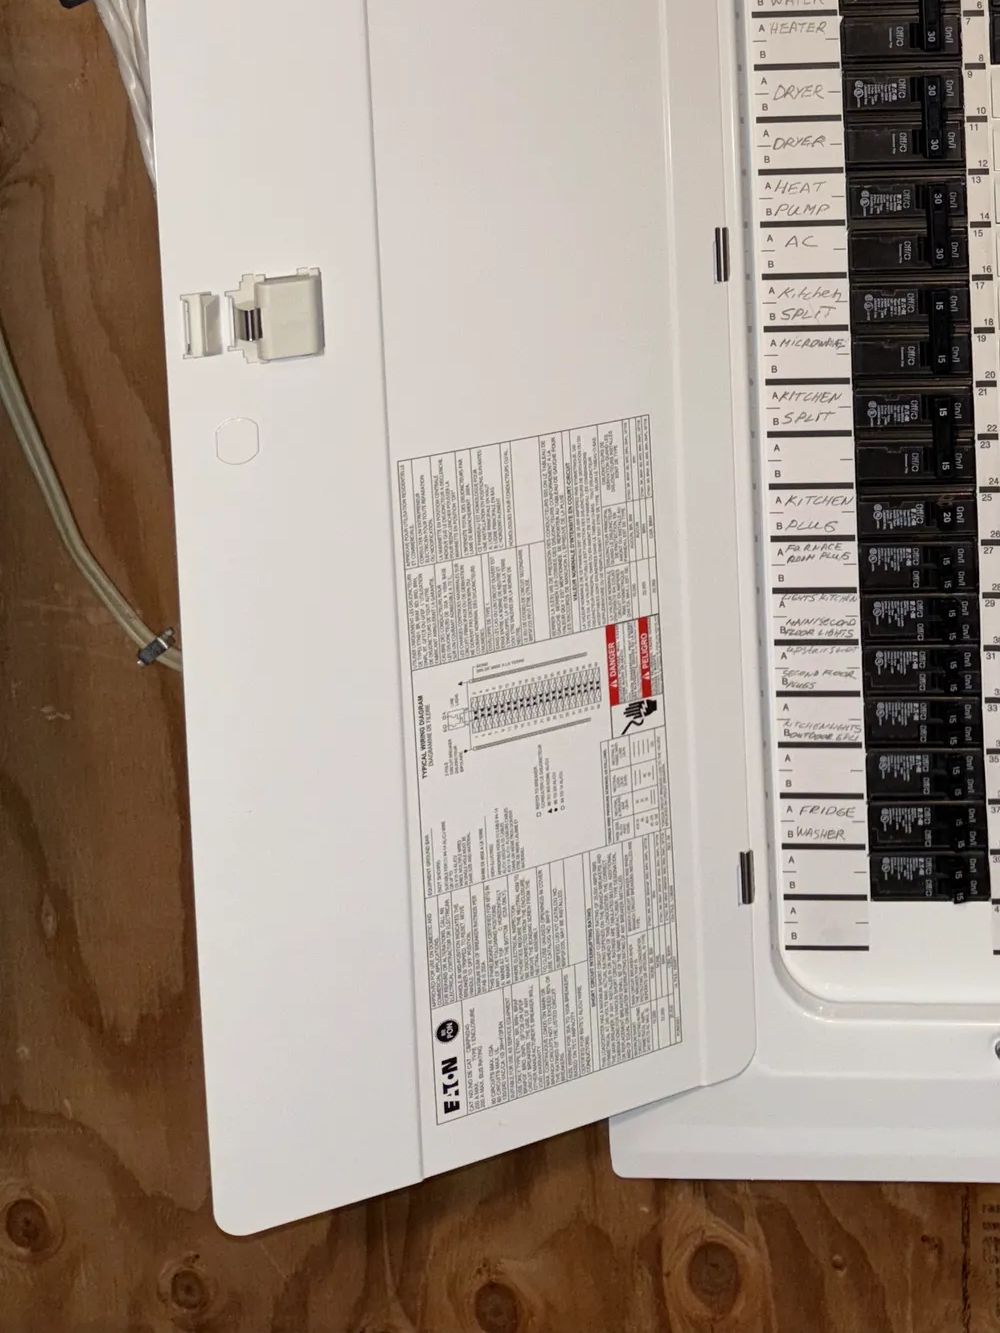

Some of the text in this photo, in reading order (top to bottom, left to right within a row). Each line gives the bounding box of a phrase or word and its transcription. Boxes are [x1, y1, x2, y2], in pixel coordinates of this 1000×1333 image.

[769, 21, 827, 34] HEATER
[927, 31, 936, 42] 30
[773, 84, 824, 100] DRYER
[976, 106, 987, 115] 10
[969, 123, 979, 131] 11
[773, 135, 826, 150] DRYER
[977, 159, 989, 168] 12
[971, 175, 982, 184] 13
[774, 179, 827, 195] HEAT
[774, 203, 830, 217] PUMP
[979, 212, 990, 220] 14
[766, 234, 774, 243] A
[973, 229, 984, 238] 15
[784, 235, 819, 248] AC
[767, 259, 775, 269] B
[981, 264, 993, 274] 16
[975, 281, 985, 290] 17
[778, 286, 844, 302] Kitchen
[781, 305, 836, 320] SPLIT
[983, 317, 995, 327] 18
[976, 334, 987, 343] 19
[984, 370, 996, 380] 20
[977, 387, 989, 396] 21
[779, 391, 842, 404] KITCHEN
[782, 412, 836, 425] SPLIT
[986, 423, 998, 433] 22
[773, 443, 781, 452] A
[979, 440, 991, 449] 23
[774, 469, 782, 479] B
[988, 476, 1000, 486] 24
[784, 495, 854, 506] KITCHEN
[981, 493, 993, 502] 25
[943, 512, 952, 523] 20
[785, 519, 838, 533] PLUG
[983, 546, 994, 555] 27
[984, 599, 996, 608] 29
[640, 632, 649, 669] PELIGRO
[985, 651, 996, 660] 31
[608, 642, 617, 677] DANGER
[417, 695, 425, 726] DIAGRAM
[987, 703, 999, 712] 33
[988, 755, 1000, 764] 35
[420, 751, 428, 779] TYPICAL
[799, 805, 856, 818] FRIDGE
[796, 826, 846, 841] WASHER
